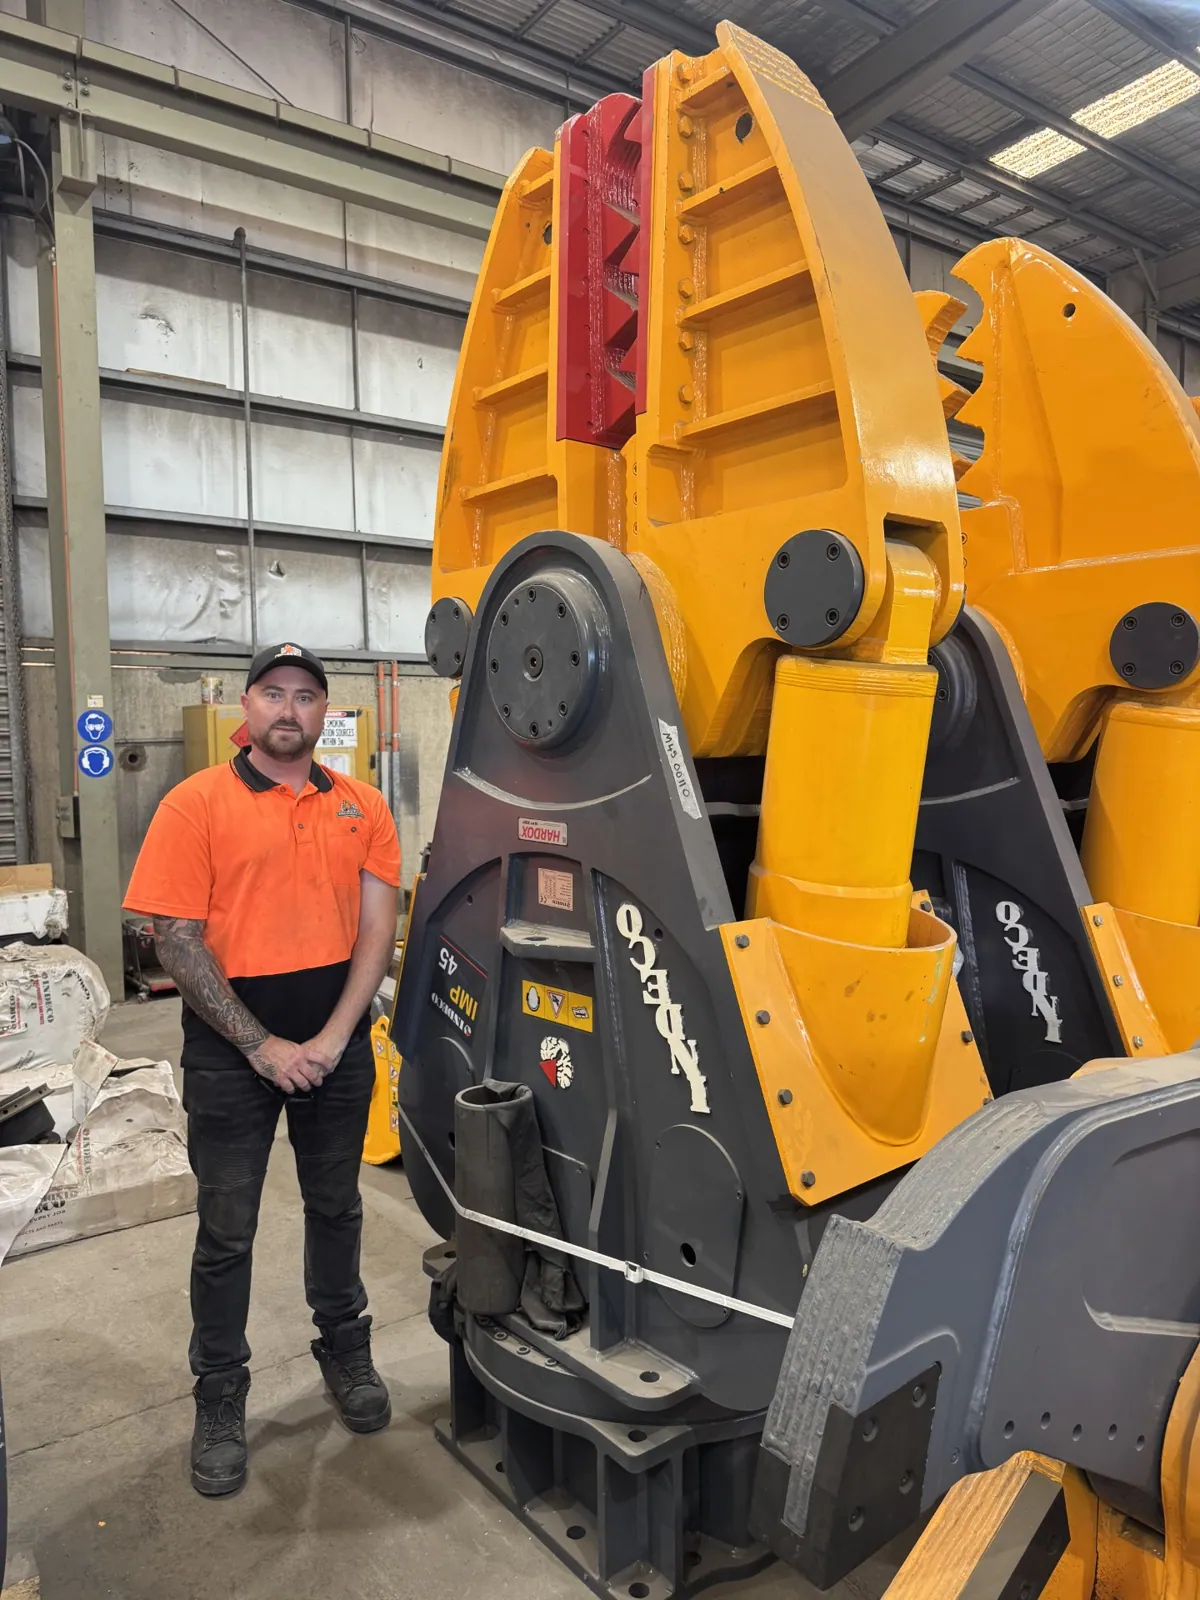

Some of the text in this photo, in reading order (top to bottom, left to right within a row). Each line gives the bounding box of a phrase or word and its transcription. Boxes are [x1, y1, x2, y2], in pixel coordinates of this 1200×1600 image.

[320, 728, 355, 737] NITION SOURCES
[326, 719, 346, 727] SMOKING
[321, 737, 336, 745] WITHIN
[521, 825, 561, 843] HARDOX
[438, 947, 458, 976] 45
[995, 900, 1063, 1043] INDECO
[42, 980, 54, 1023] INDECO
[431, 992, 465, 1031] INDECO
[449, 985, 478, 1021] IMP
[616, 904, 711, 1113] INDECO
[48, 1220, 63, 1228] PARTS
